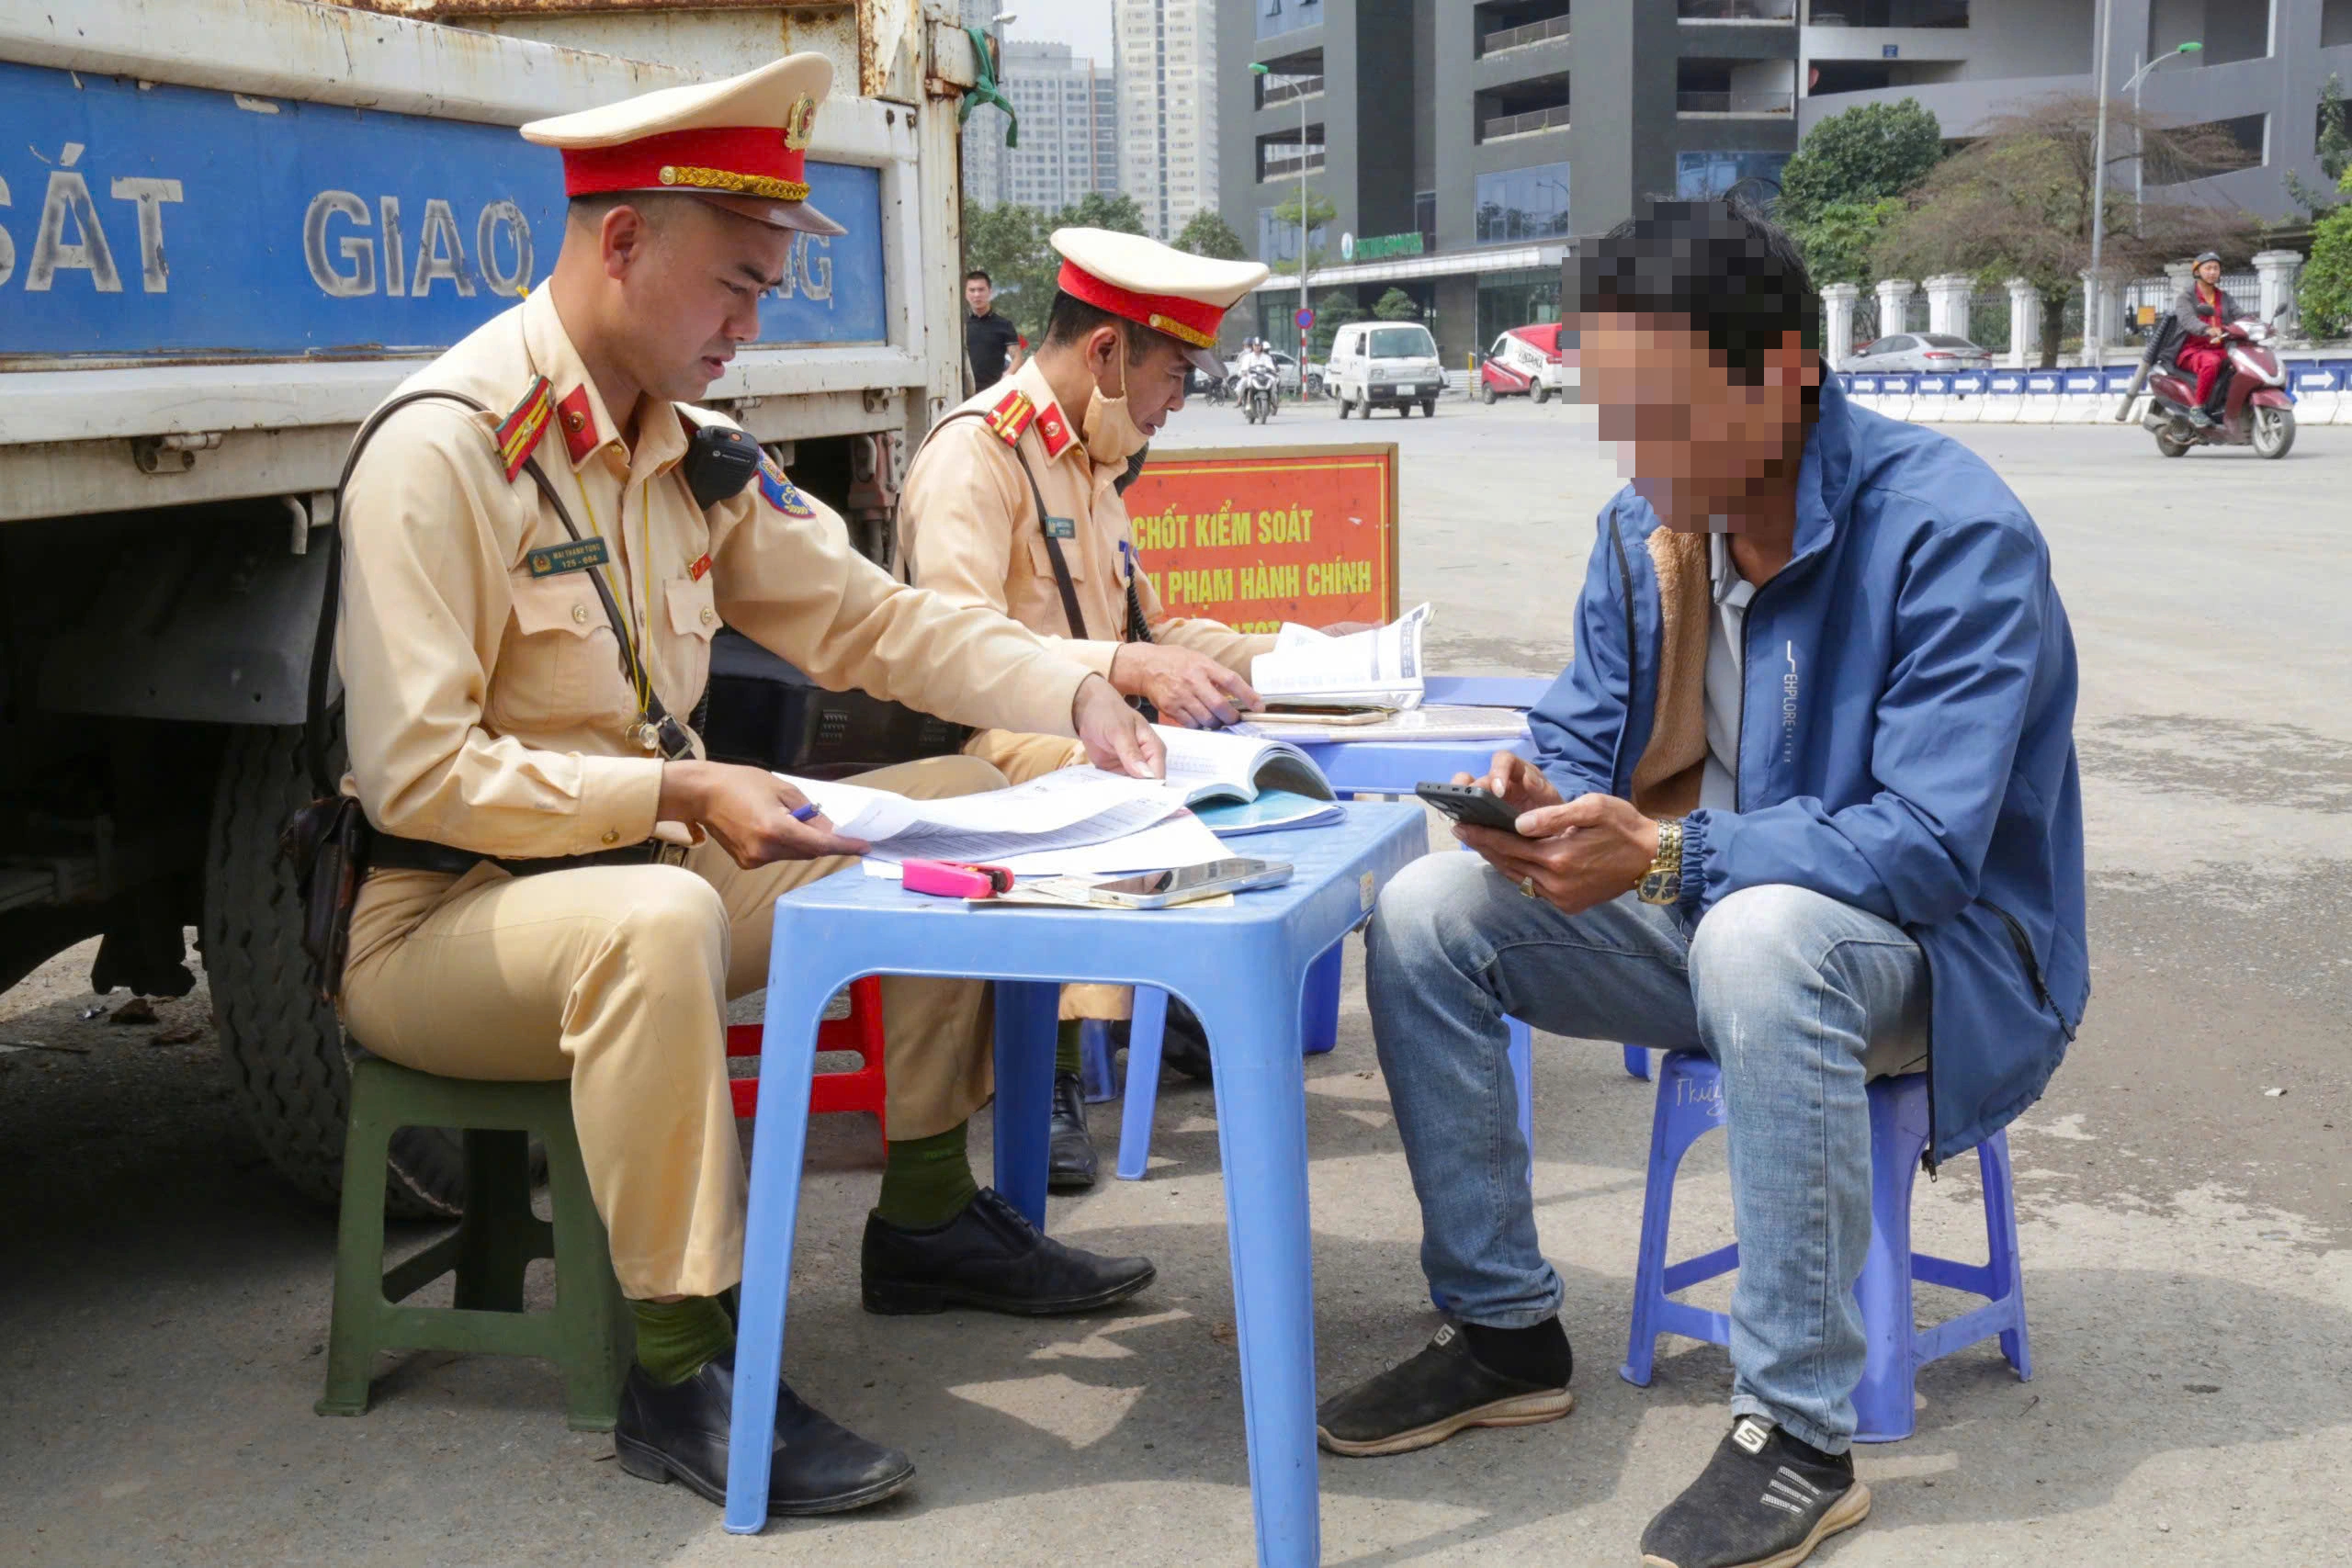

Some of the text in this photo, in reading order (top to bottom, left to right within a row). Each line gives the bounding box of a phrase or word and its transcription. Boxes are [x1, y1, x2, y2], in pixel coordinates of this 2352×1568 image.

[0, 142, 184, 293] ÁT
[303, 189, 535, 298] GIAO
[1132, 499, 1313, 551] CHỐT KIỂM SOÁT
[1168, 568, 1234, 611] PHẠM
[1240, 558, 1300, 600] HÀNH
[1306, 555, 1372, 596] CHÍNH
